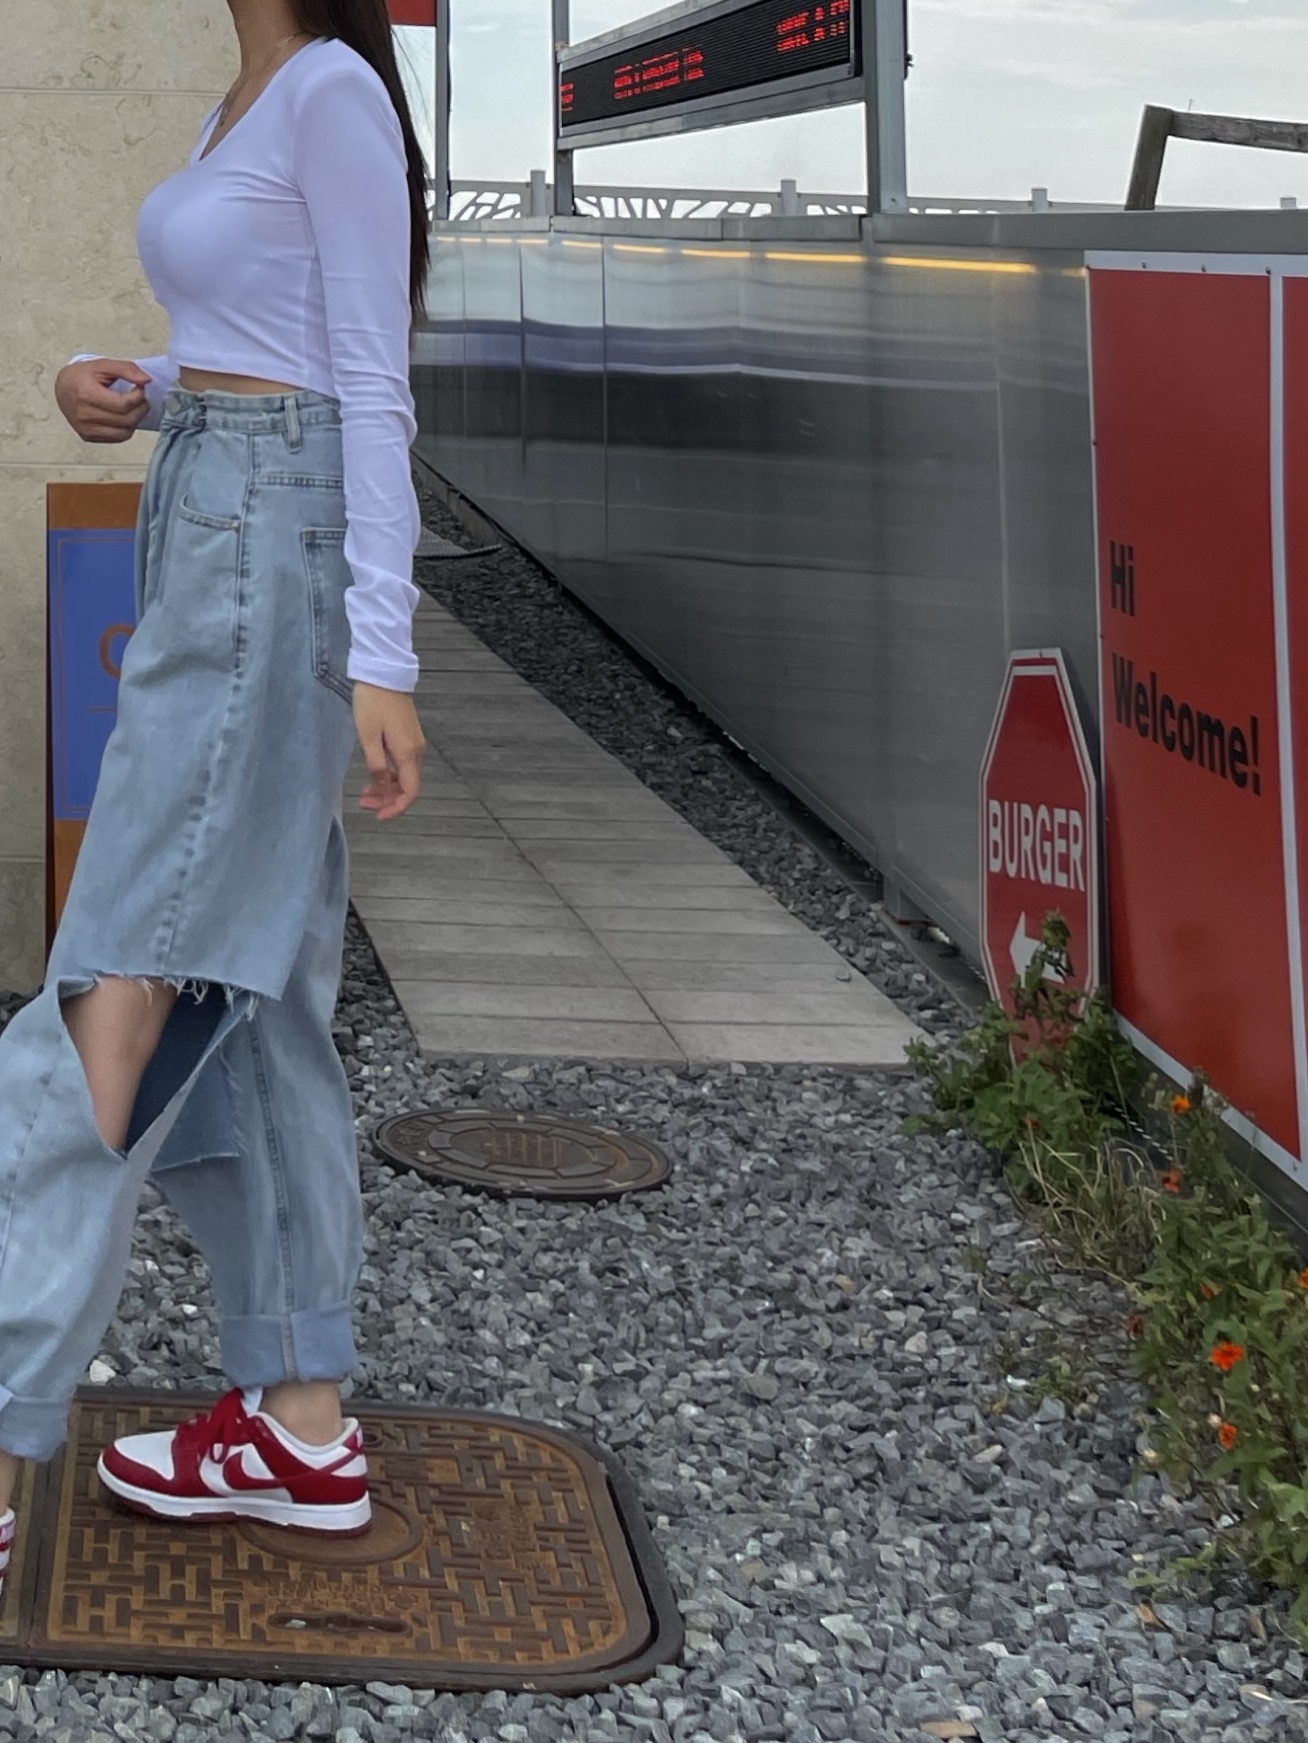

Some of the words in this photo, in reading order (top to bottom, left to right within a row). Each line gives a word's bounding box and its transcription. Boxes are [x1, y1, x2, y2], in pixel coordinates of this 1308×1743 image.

[1108, 540, 1136, 617] Hi
[1112, 651, 1262, 797] Welcome!
[987, 798, 1086, 894] BURGER
